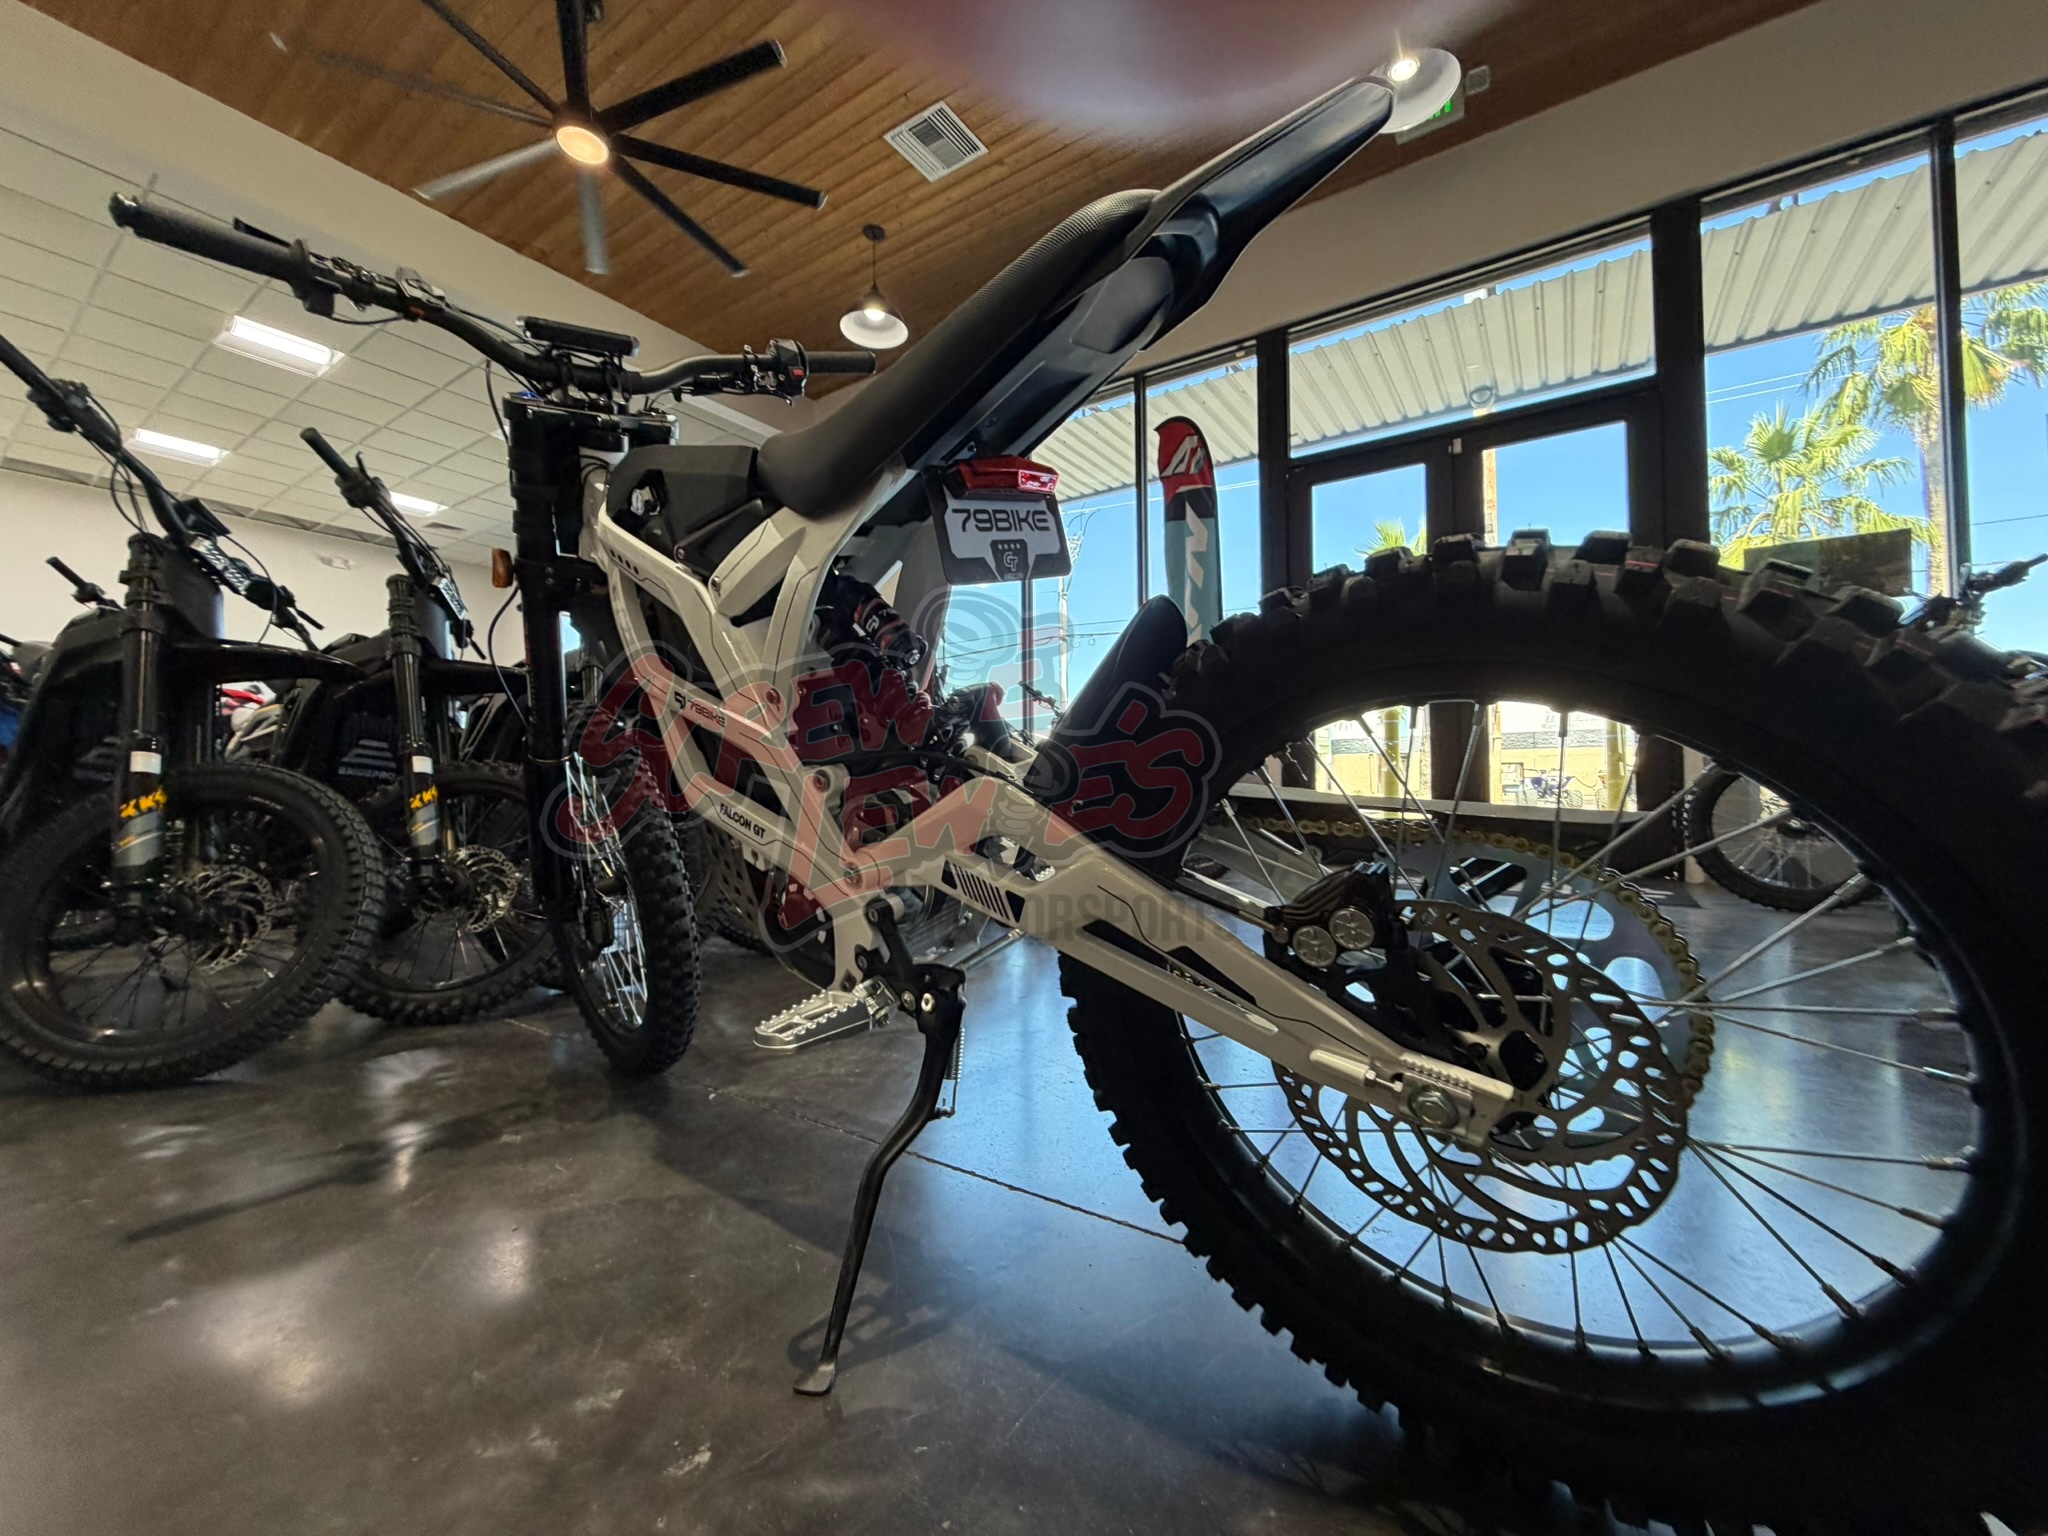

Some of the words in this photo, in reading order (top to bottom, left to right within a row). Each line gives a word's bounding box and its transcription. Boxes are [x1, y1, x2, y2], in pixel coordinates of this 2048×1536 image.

[952, 508, 1050, 532] 79BIKE
[719, 803, 752, 831] FALCON
[753, 824, 766, 839] GT
